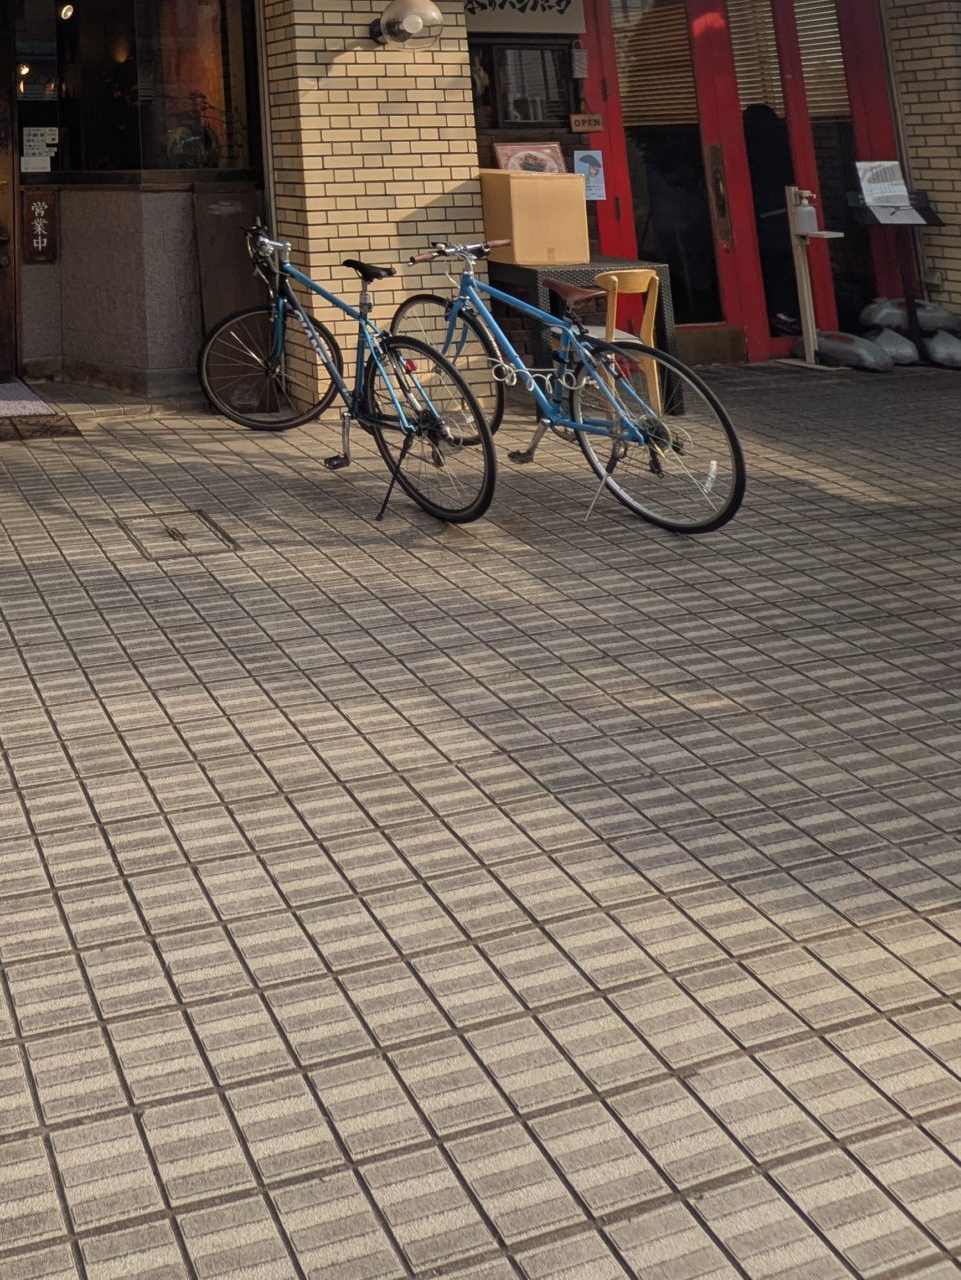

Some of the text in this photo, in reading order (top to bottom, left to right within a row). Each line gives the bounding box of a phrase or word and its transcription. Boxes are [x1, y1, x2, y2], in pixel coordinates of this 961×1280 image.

[573, 118, 601, 127] OPEN
[31, 201, 48, 251] 営業中
